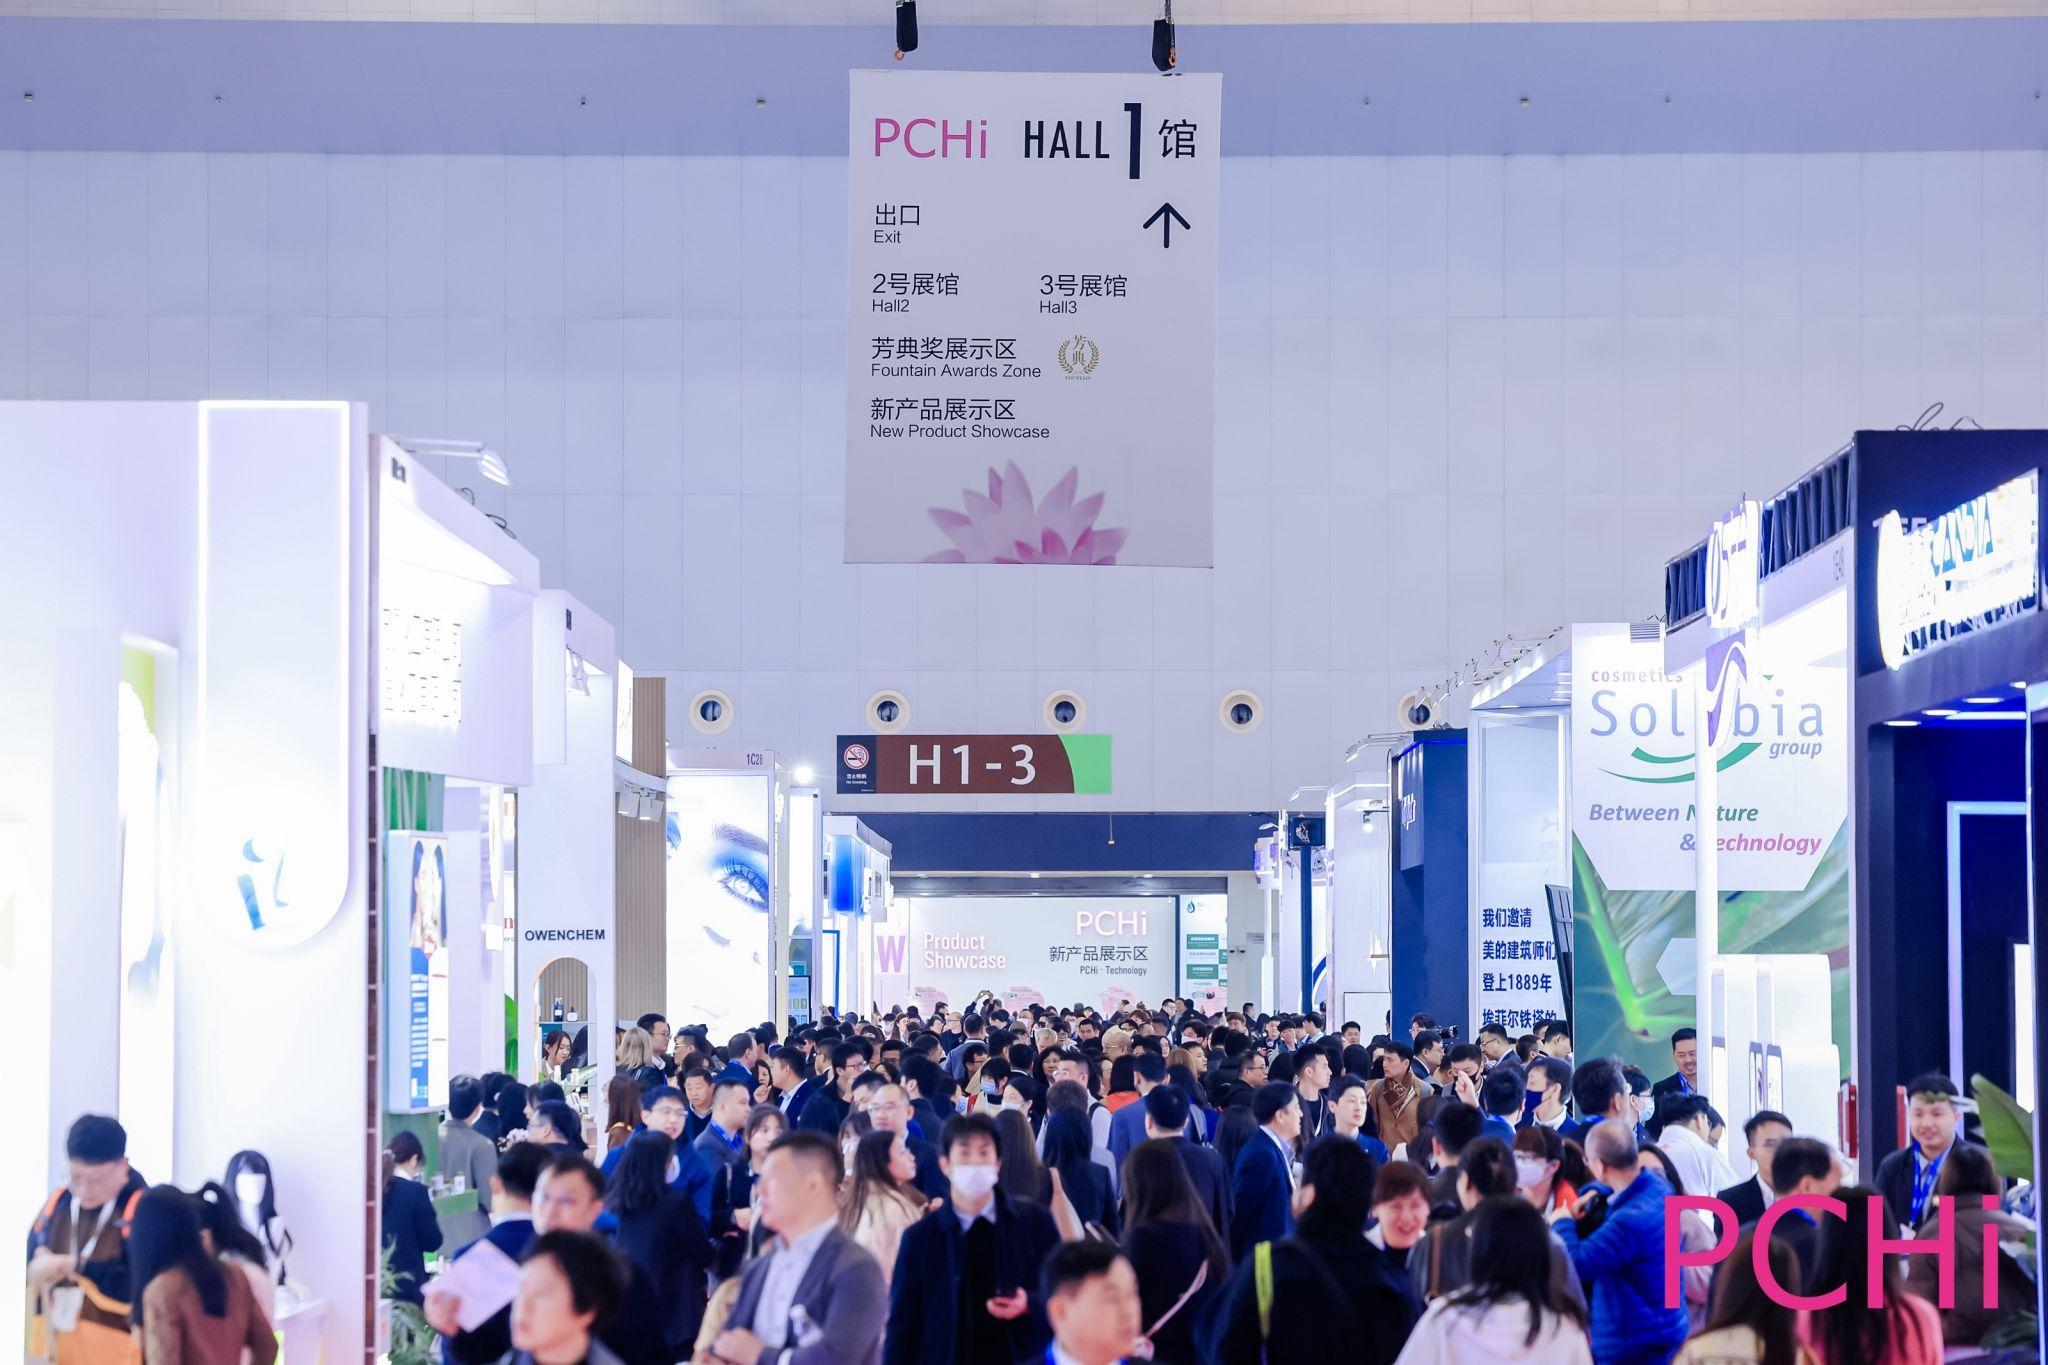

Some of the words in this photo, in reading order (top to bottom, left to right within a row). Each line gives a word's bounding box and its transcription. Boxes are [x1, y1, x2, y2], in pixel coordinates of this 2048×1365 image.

[874, 118, 988, 159] PCHi
[1024, 119, 1110, 159] HALL
[1123, 102, 1142, 179] 1
[1158, 118, 1198, 159] 馆
[875, 203, 921, 226] 出口
[874, 229, 902, 244] Exit
[872, 272, 960, 297] 2号展馆
[1040, 274, 1128, 299] 3号展馆
[872, 298, 910, 313] Hall2
[1039, 299, 1078, 315] Hall3
[871, 337, 1017, 361] 芳典奖展示区
[871, 363, 937, 378] Fountain
[941, 363, 998, 378] Awards
[1002, 364, 1042, 379] Zone
[870, 397, 1016, 421] 新产品展示区
[870, 424, 904, 438] New
[908, 424, 967, 439] Product
[971, 424, 1050, 439] Showcase
[1590, 687, 1824, 738] Solbia
[1768, 740, 1823, 760] group
[1589, 803, 1680, 822] Between
[1686, 803, 1759, 822] Nture
[1716, 833, 1822, 856] echnology
[1076, 910, 1148, 936] PCHi
[1482, 907, 1532, 928] 我们邀请
[524, 929, 606, 941] OWENCHEM
[923, 931, 986, 950] Product
[923, 950, 1006, 969] Showcase
[1049, 945, 1149, 962] 新产品展示区
[1482, 939, 1557, 960] 美的建筑师们
[1080, 965, 1099, 975] PCHi
[1105, 965, 1148, 977] Technology
[1482, 972, 1553, 993] 登上1889年
